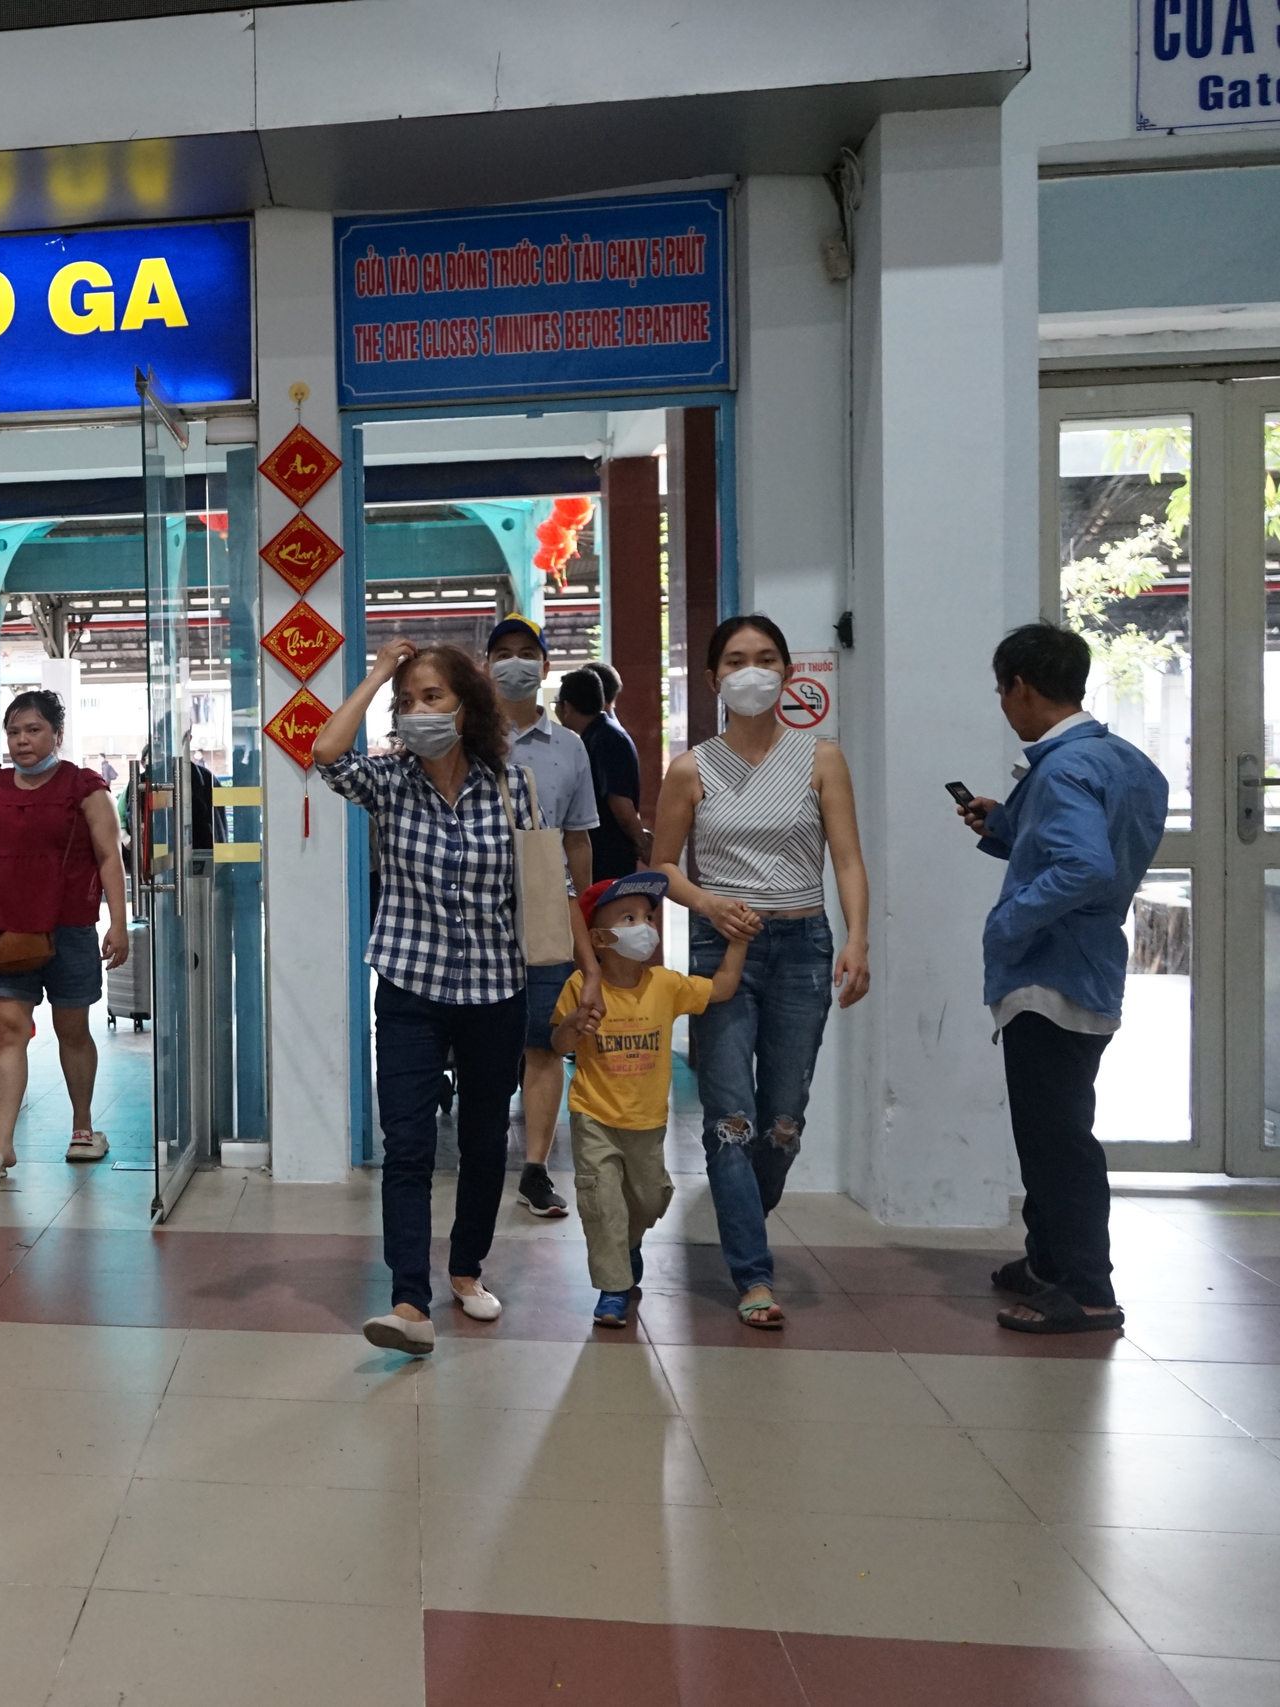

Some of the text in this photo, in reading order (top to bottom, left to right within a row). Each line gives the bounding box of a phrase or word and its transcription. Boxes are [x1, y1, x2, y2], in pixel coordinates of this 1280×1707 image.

[1198, 73, 1280, 111] Gat
[355, 226, 706, 297] CỬA VÀO GA ĐÓNG TRƯỚC GIỜ TÀU CHẠY 5 PHÚT
[47, 257, 190, 335] GA
[353, 301, 711, 364] THE GATE CLOSES 5 MINUTES BEFORE DEPARTURE
[279, 542, 322, 570] Khang
[594, 1030, 660, 1054] RENOVATE
